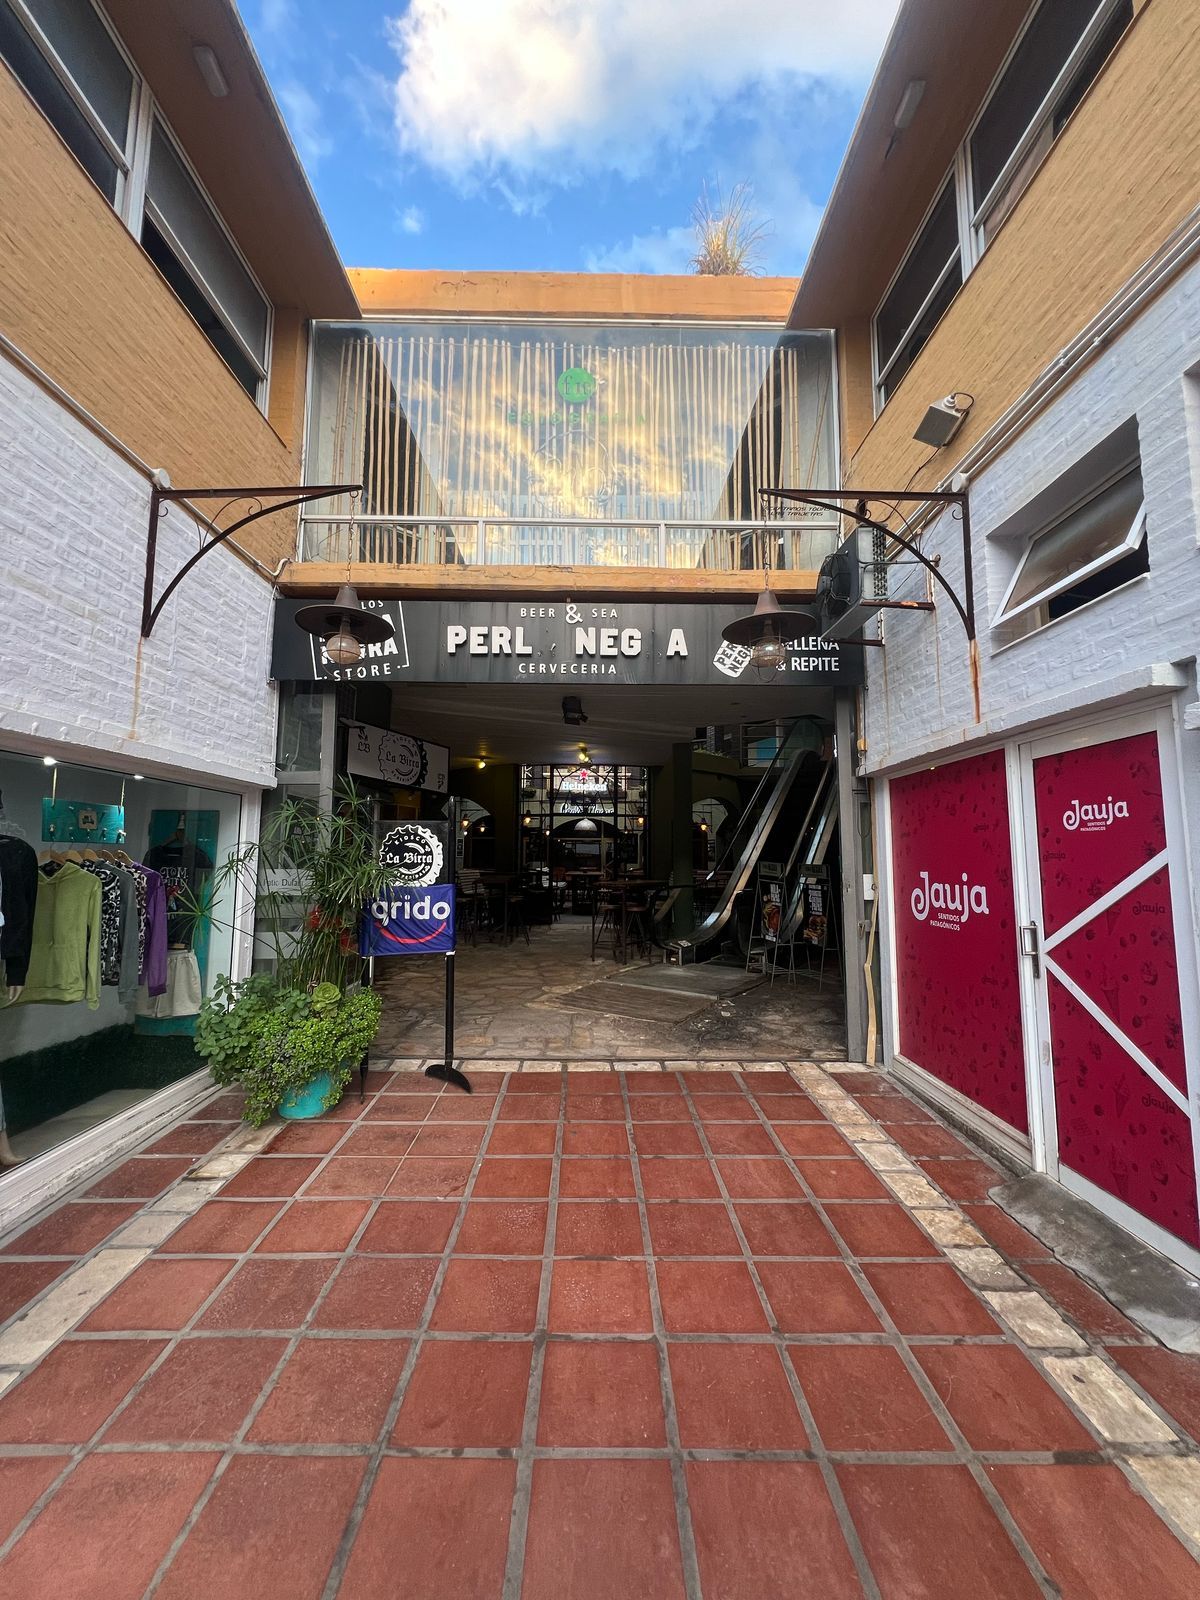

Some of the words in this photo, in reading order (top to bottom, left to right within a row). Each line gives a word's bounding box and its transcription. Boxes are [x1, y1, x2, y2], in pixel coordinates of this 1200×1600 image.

[520, 607, 556, 618] BEER
[565, 604, 584, 623] &
[592, 608, 618, 618] SEA
[783, 636, 840, 651] ELLENA
[518, 663, 617, 675] CERVECERIA
[791, 657, 840, 671] REPITE
[333, 663, 391, 681] STORE
[385, 751, 396, 763] La
[399, 754, 421, 769] Birra
[561, 781, 607, 791] Heineken
[1063, 796, 1130, 830] Jauja
[394, 834, 426, 846] KIOSCO
[386, 853, 400, 863] La
[403, 852, 433, 864] Birra
[911, 871, 989, 923] Jauja
[371, 894, 451, 927] grido
[1132, 901, 1166, 915] Jauja
[937, 912, 960, 922] SENTIDOS
[929, 919, 961, 931] PATAGÓNICOS
